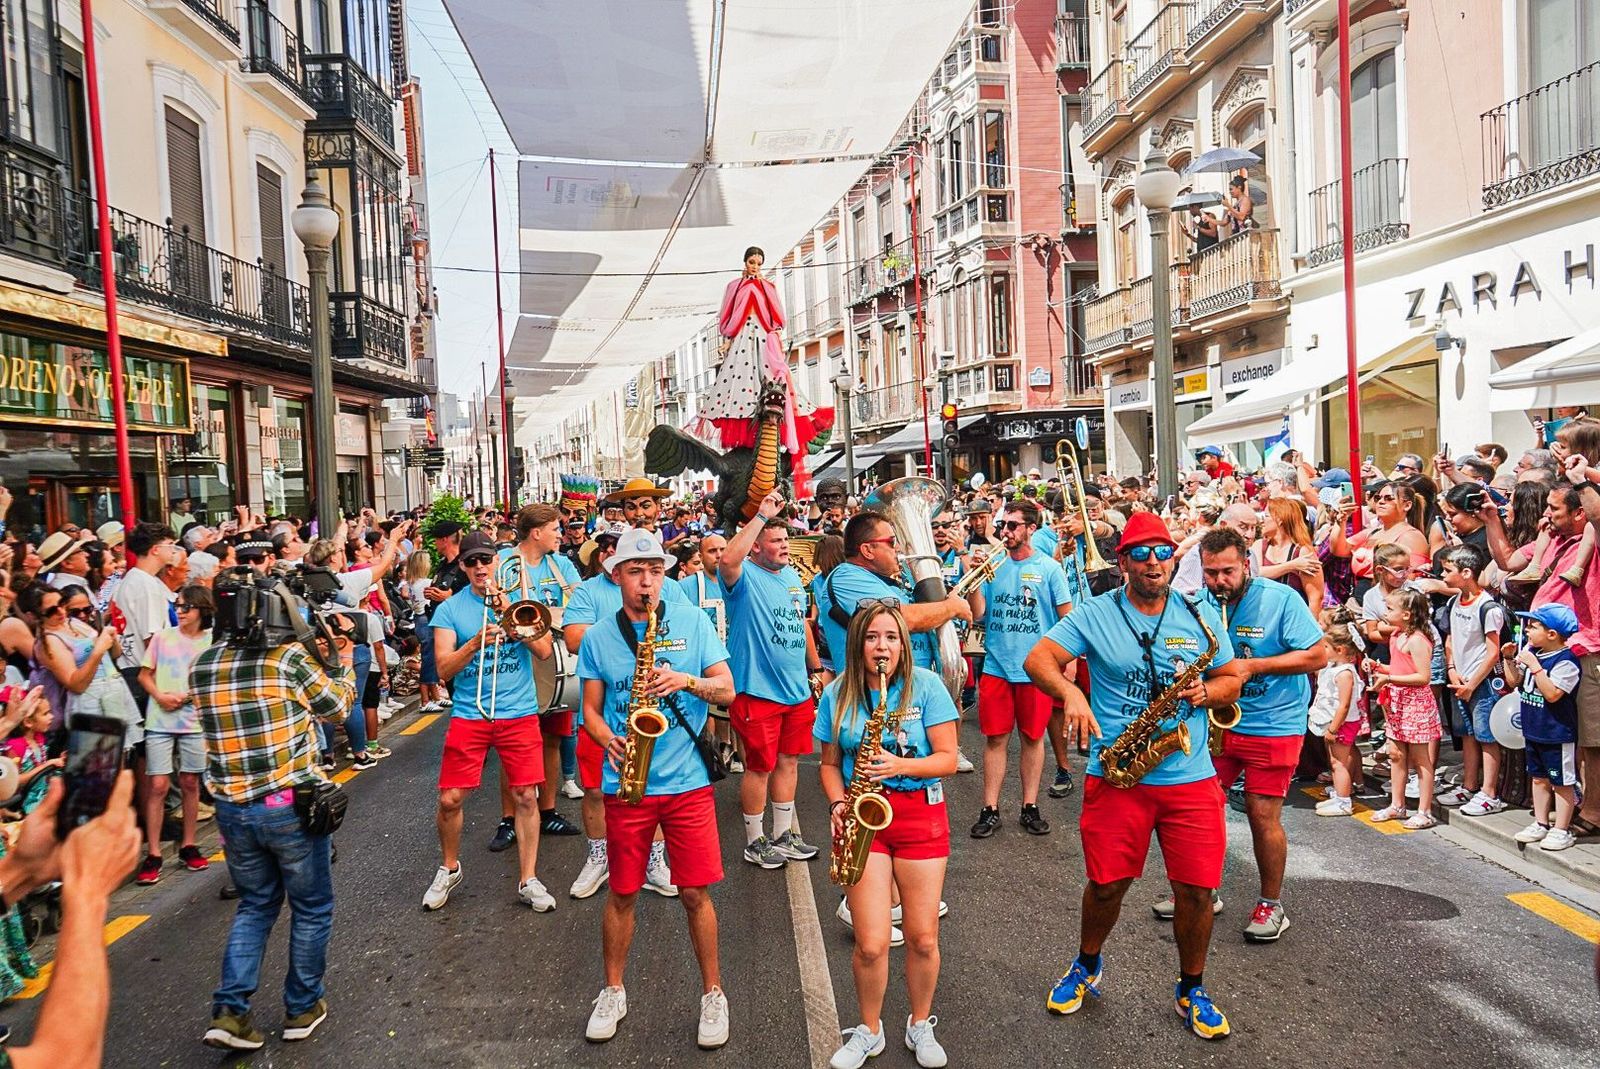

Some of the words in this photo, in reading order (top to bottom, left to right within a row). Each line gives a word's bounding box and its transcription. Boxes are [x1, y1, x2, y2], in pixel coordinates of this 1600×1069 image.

[1404, 261, 1542, 322] ZARA
[1232, 363, 1274, 384] exchange
[1120, 389, 1141, 404] cambio
